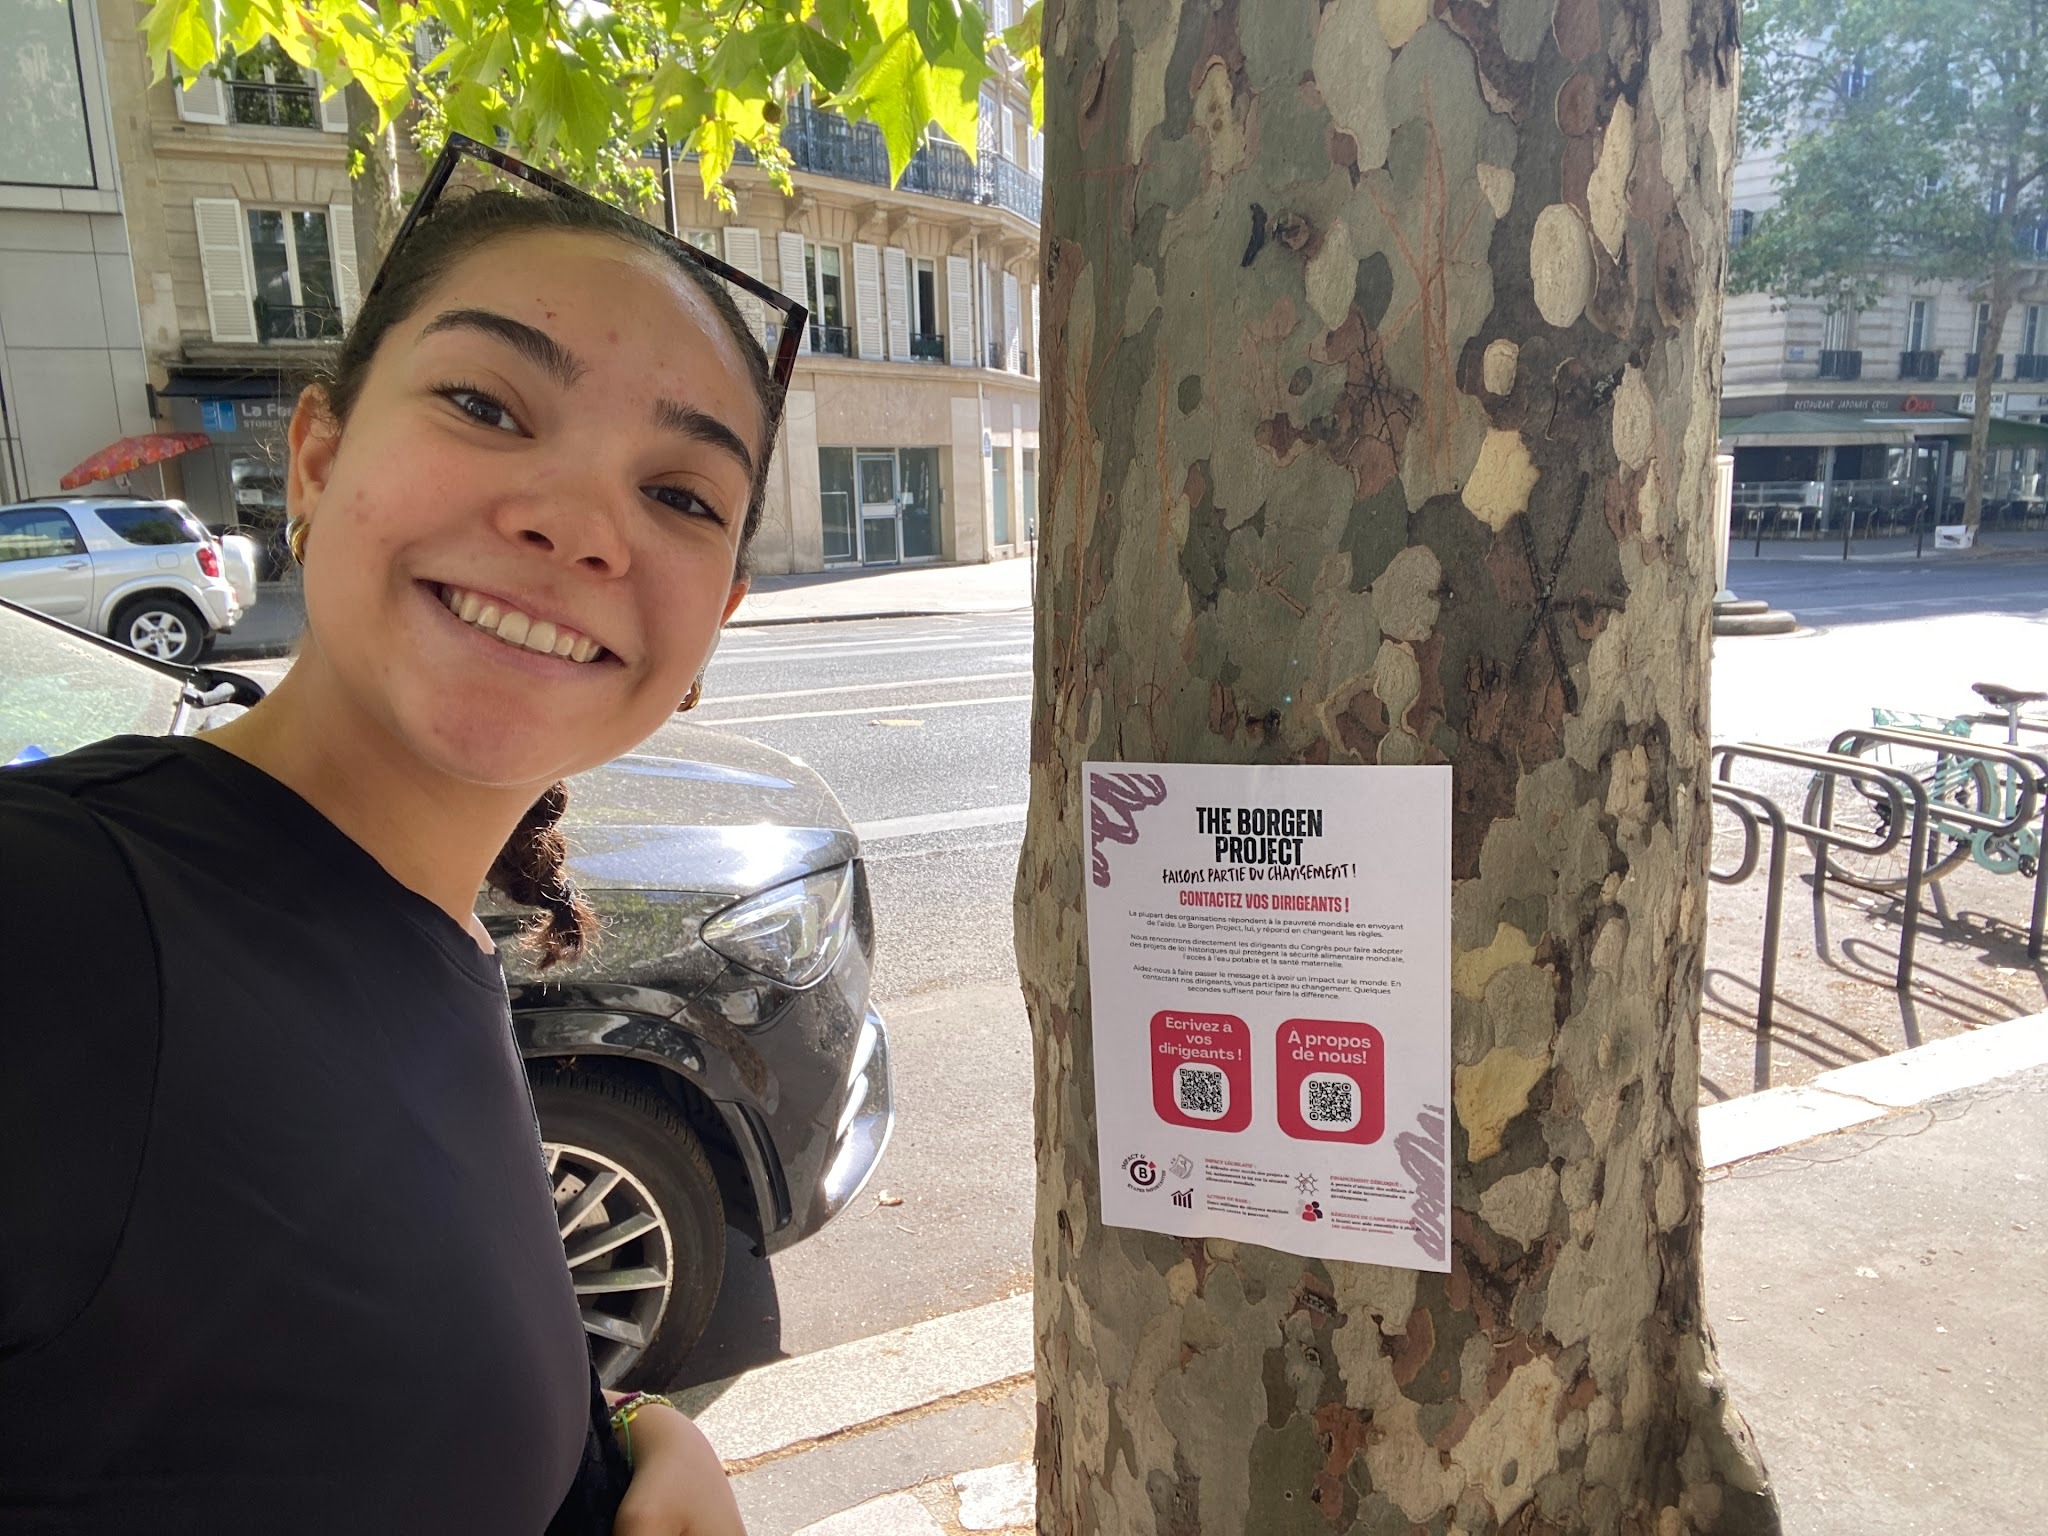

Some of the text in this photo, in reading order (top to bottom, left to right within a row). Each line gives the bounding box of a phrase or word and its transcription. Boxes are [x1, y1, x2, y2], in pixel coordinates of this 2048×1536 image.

[241, 403, 262, 416] La
[1794, 400, 1834, 409] RESTAURANT
[1196, 807, 1322, 837] THE BORGEN
[1216, 837, 1303, 865] PROJECT
[1250, 869, 1264, 881] DU
[1180, 891, 1242, 908] CONTACTEZ
[1246, 894, 1268, 909] VOS
[1272, 895, 1342, 913] DIRIGEANTS
[1139, 910, 1163, 920] plupart
[1179, 914, 1226, 922] organisations
[1368, 923, 1403, 931] envoyant
[1188, 921, 1214, 931] Borgen
[1303, 927, 1343, 937] changeant
[1143, 943, 1166, 952] projets
[1188, 945, 1227, 955] historiques
[1229, 948, 1240, 956] qui
[1321, 952, 1363, 960] alimentaire
[1193, 937, 1236, 946] directement
[1250, 940, 1287, 950] dirigeants
[1373, 946, 1402, 956] adopter
[1232, 956, 1259, 964] potable
[1133, 965, 1170, 974] Aidez-nous
[1228, 973, 1260, 981] message
[1309, 975, 1334, 985] impact
[1143, 974, 1179, 982] contactant
[1253, 980, 1288, 990] participez
[1354, 986, 1390, 995] Quelques
[1186, 1035, 1212, 1045] vos
[1306, 1035, 1371, 1050] propos
[1159, 1042, 1234, 1060] dirigeants
[1292, 1047, 1366, 1064] de nous!
[1139, 1167, 1147, 1178] B
